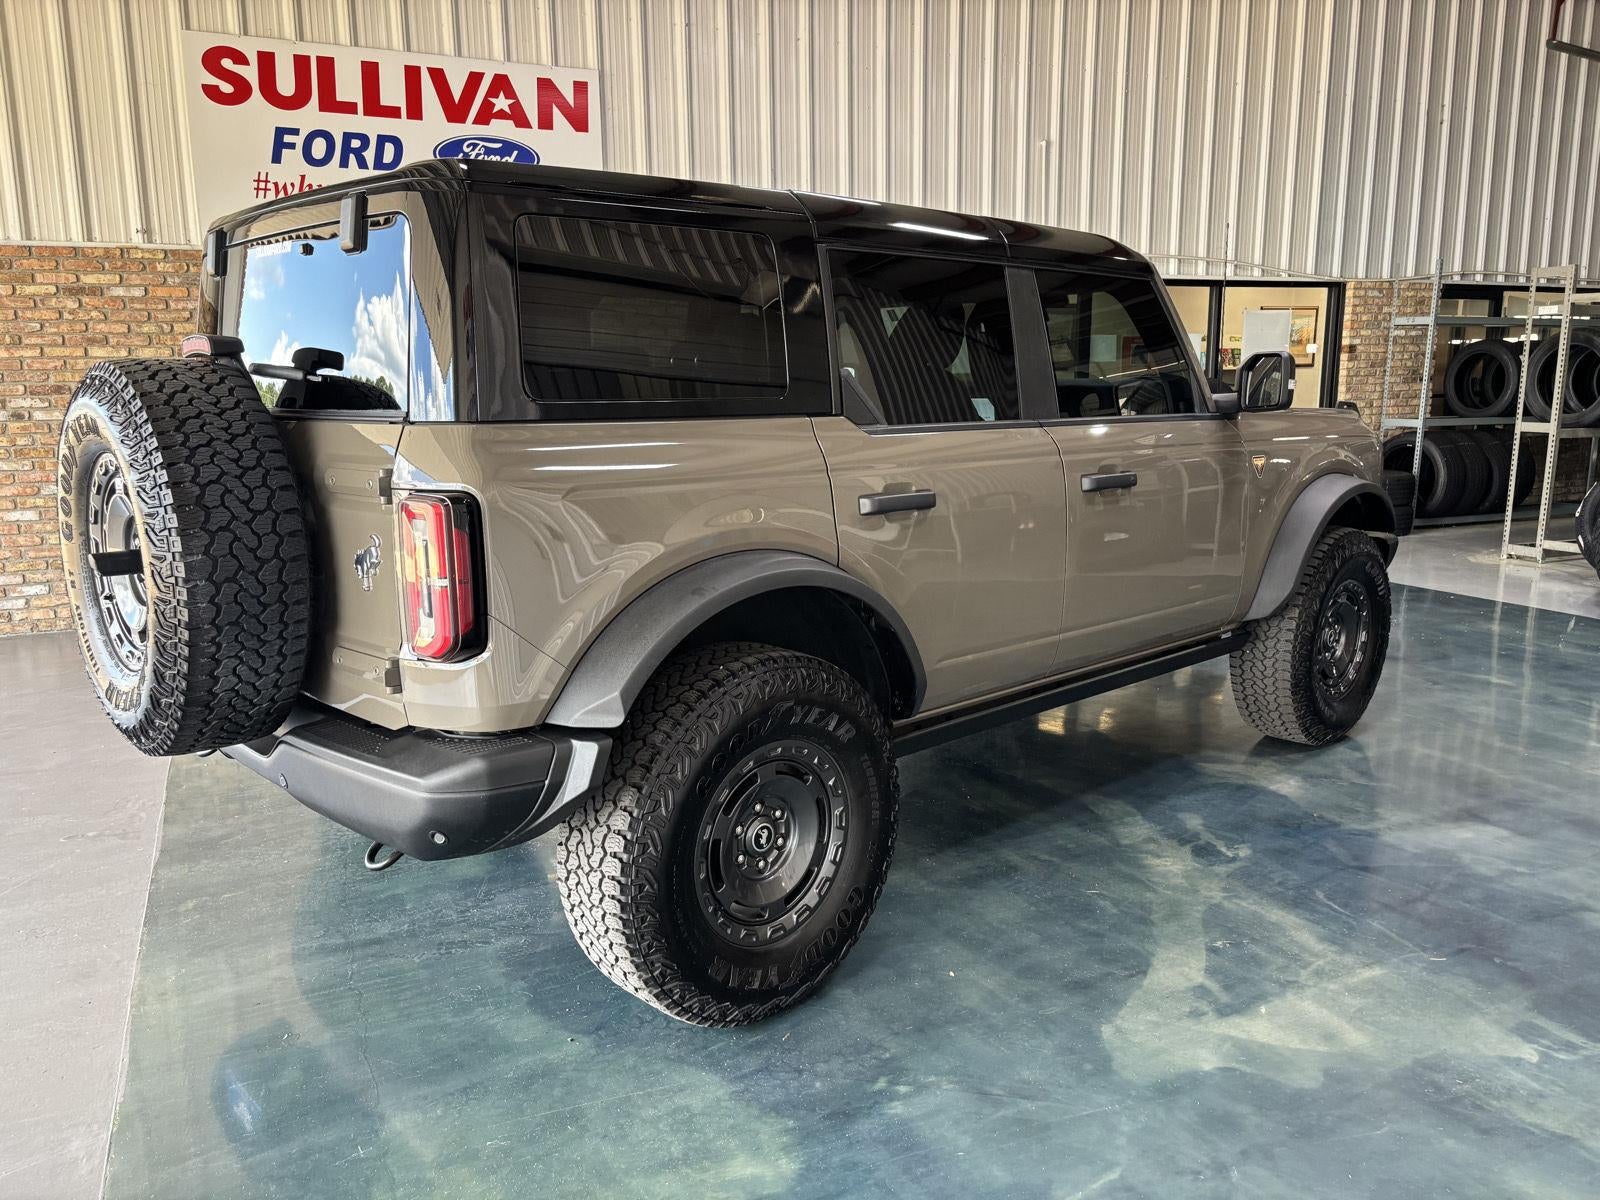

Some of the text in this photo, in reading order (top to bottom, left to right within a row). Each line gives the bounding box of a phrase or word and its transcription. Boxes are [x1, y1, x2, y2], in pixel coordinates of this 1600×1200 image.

[201, 45, 589, 133] SULLIVAN
[271, 126, 404, 171] FORD
[253, 171, 327, 199] #wh
